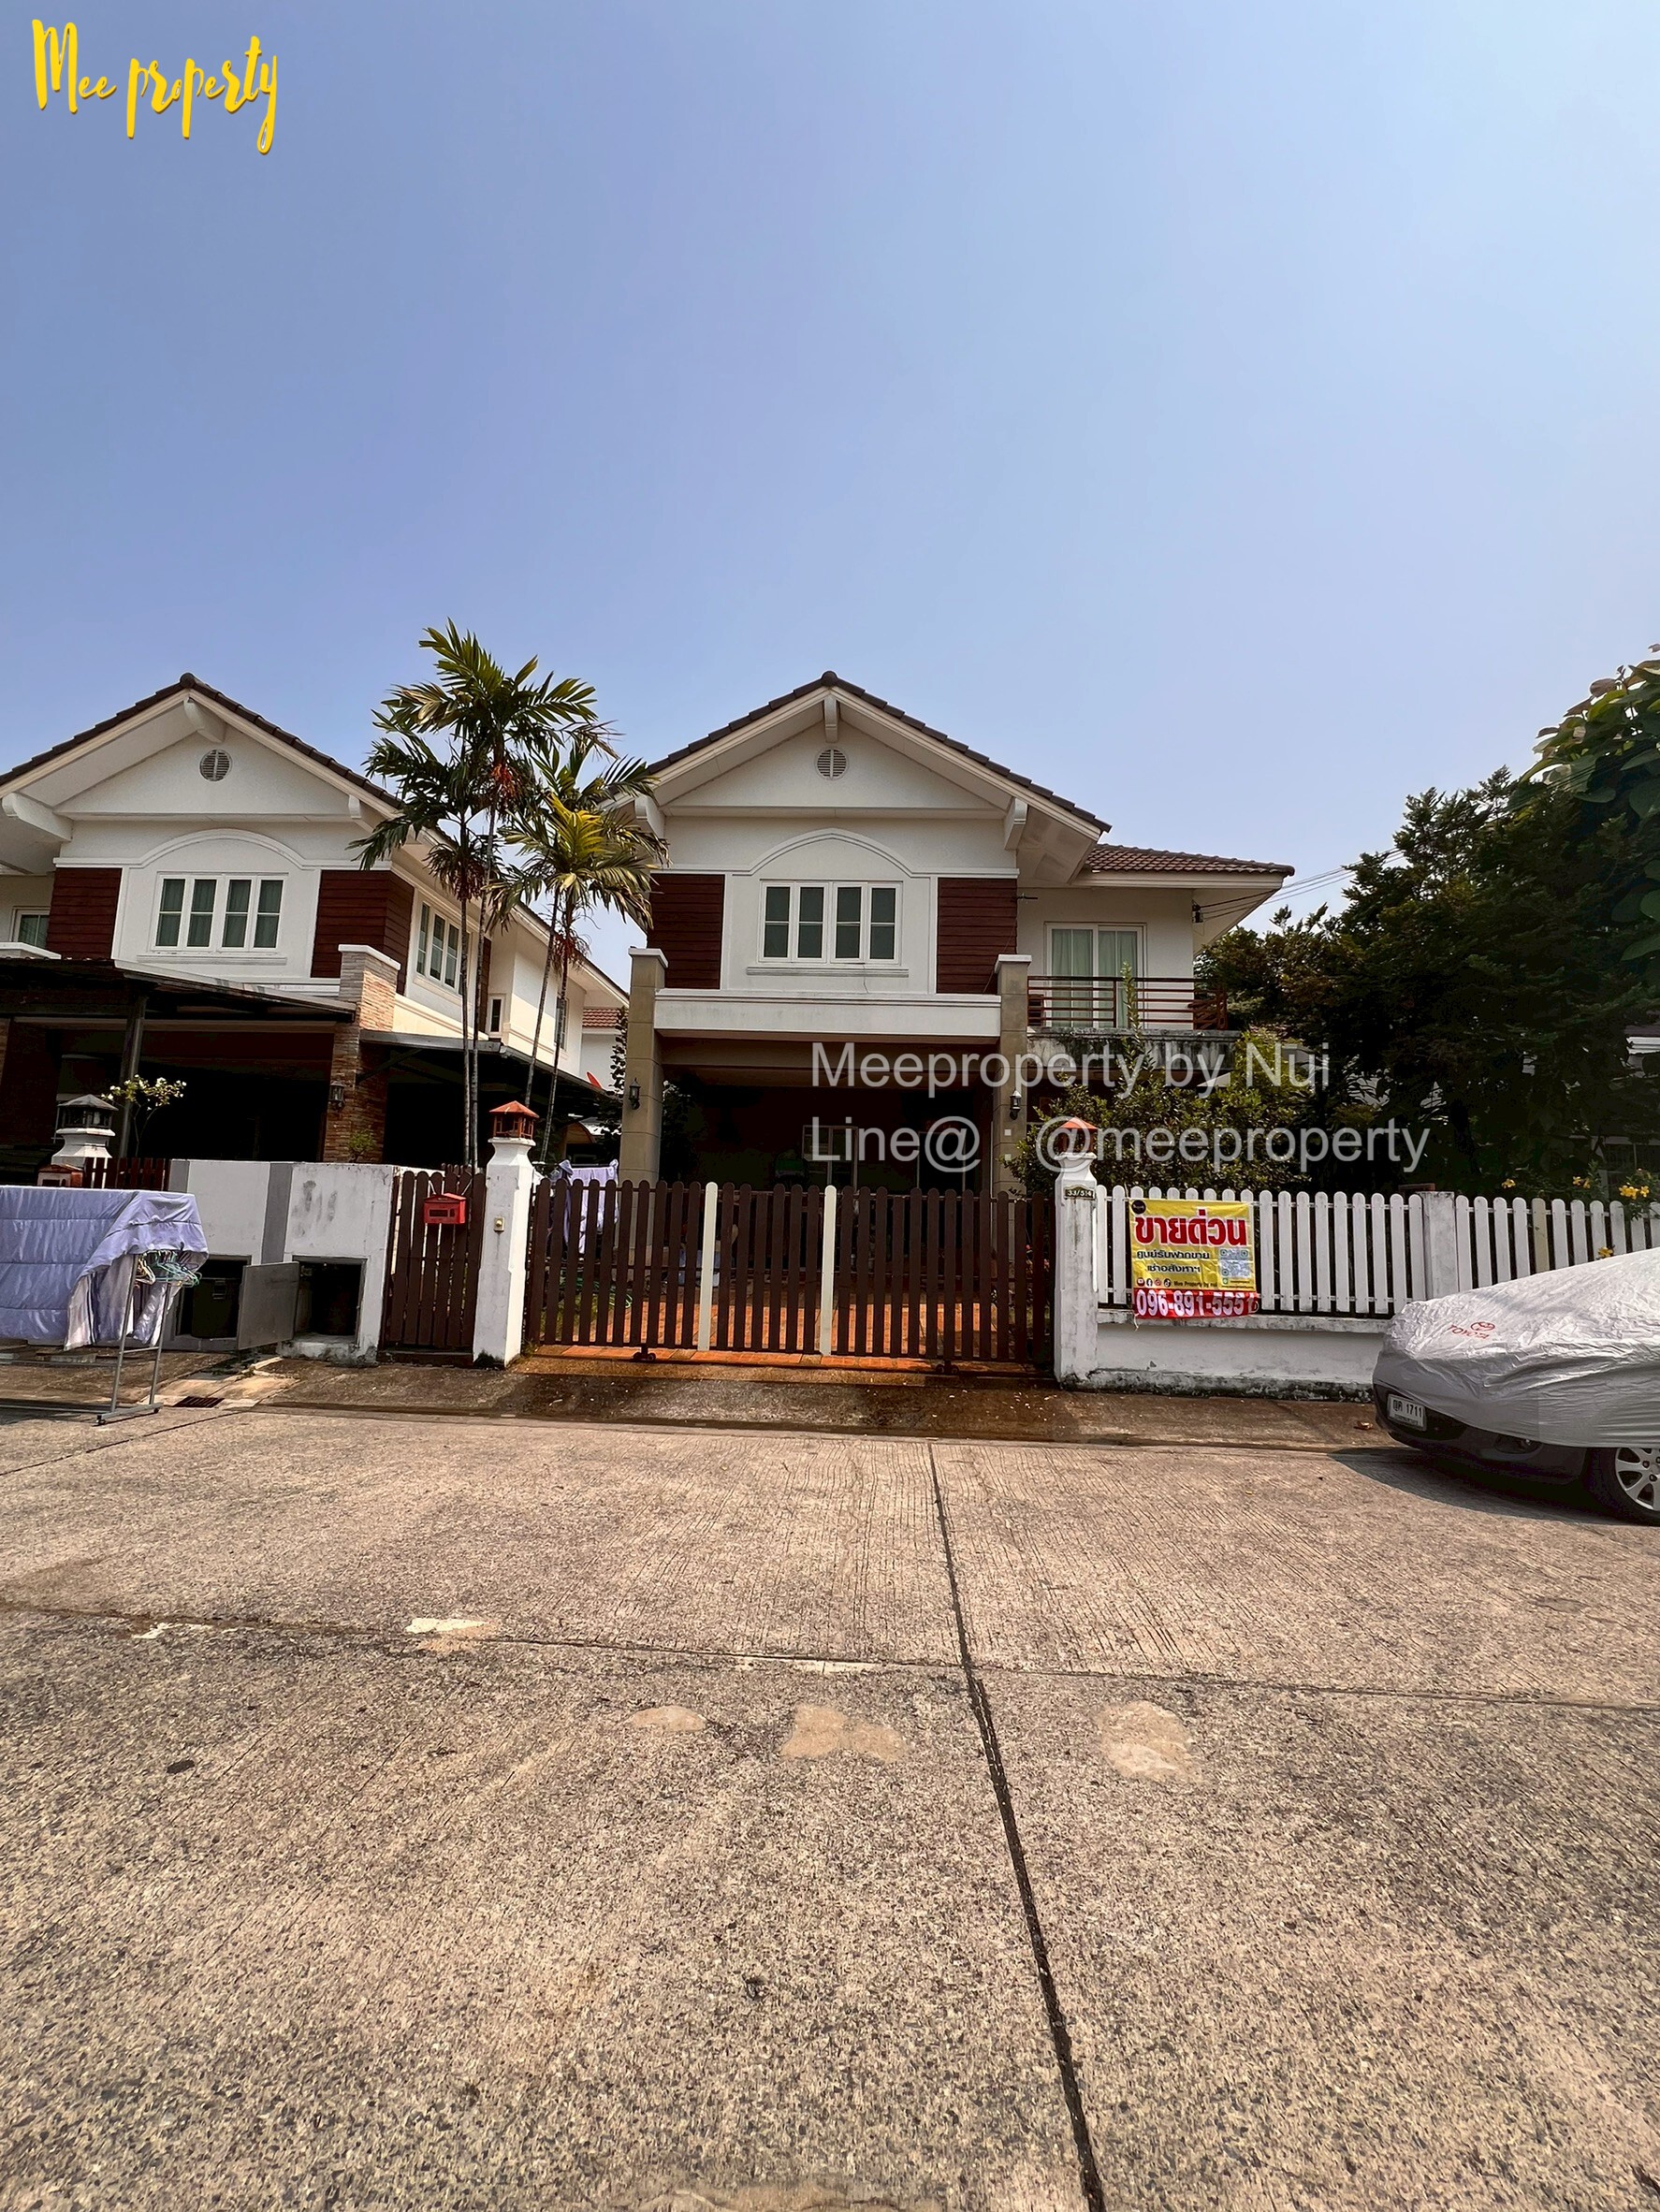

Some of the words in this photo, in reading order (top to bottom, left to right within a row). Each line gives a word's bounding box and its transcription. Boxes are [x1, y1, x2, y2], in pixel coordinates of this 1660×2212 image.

[1134, 1208, 1247, 1245] ขายด่วน
[1406, 1404, 1422, 1418] 1711
